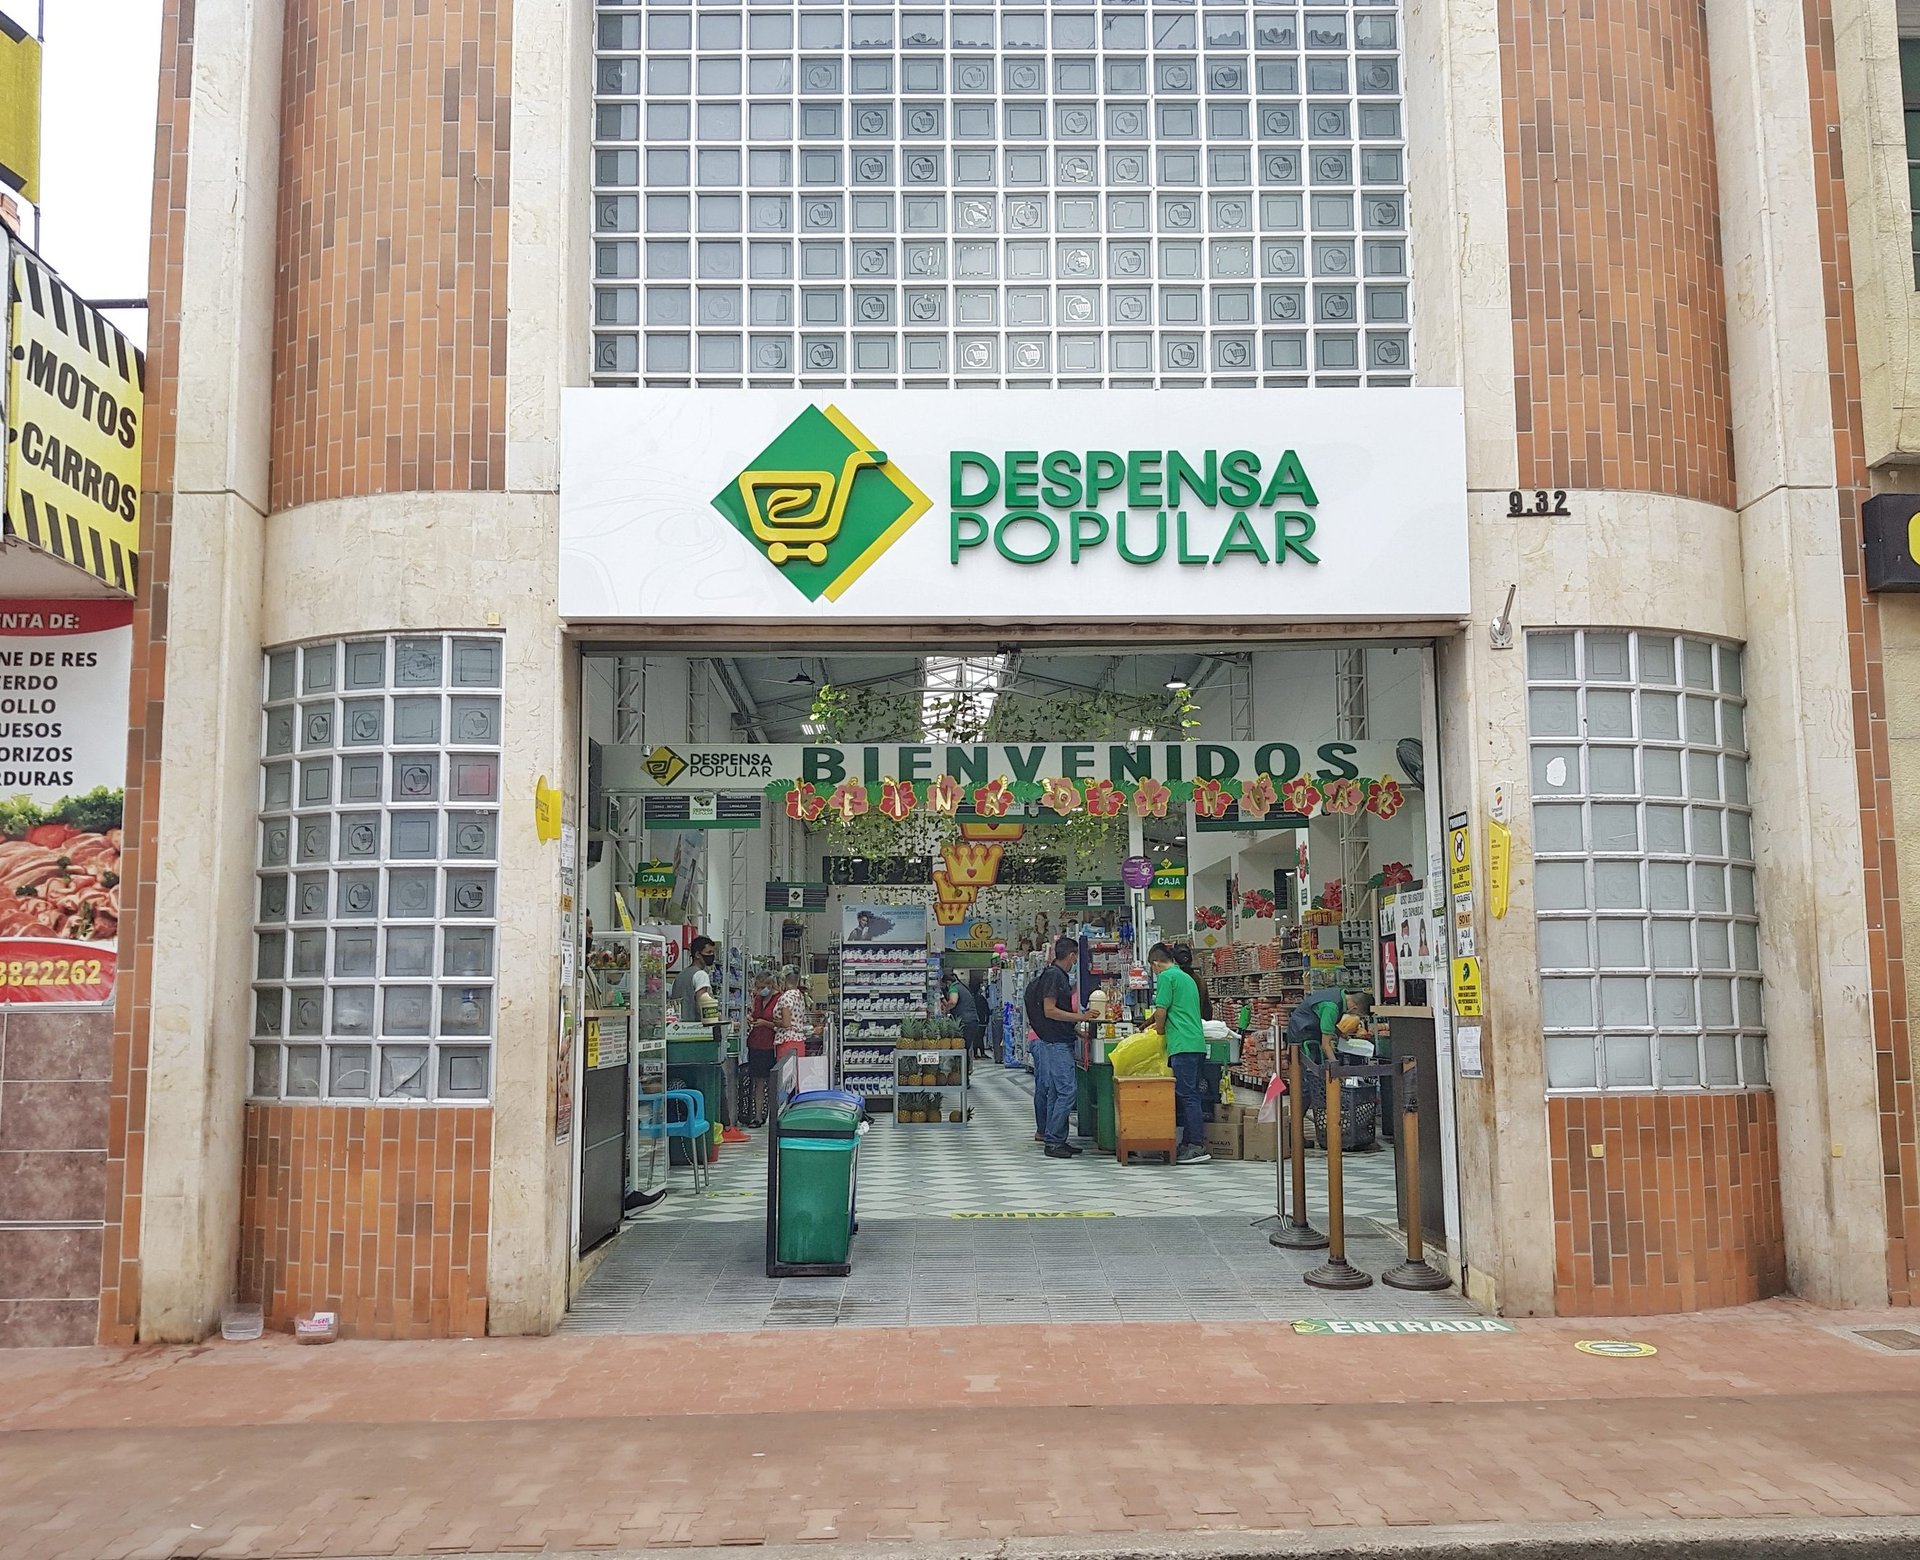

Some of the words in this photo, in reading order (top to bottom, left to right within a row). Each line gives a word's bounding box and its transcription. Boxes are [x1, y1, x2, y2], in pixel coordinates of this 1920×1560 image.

[27, 338, 137, 449] MOTOS
[21, 421, 137, 523] CARROS
[949, 449, 1320, 509] DESPENSA
[1508, 490, 1569, 514] 9.32
[950, 510, 1322, 565] POPULAR
[0, 613, 43, 629] NTA
[49, 613, 80, 629] DE:
[30, 652, 56, 667] DE
[61, 652, 98, 668] RES
[0, 675, 58, 690] ERDO
[690, 753, 773, 766] DESPENSA
[802, 742, 1359, 784] BIENVENIDOS
[690, 765, 772, 777] POPULAR
[642, 874, 666, 883] CAJA
[1157, 877, 1181, 885] CAJA
[651, 888, 658, 897] 2
[661, 888, 668, 897] 3
[1164, 889, 1170, 898] 4
[1324, 1319, 1513, 1333] ENTRADA
